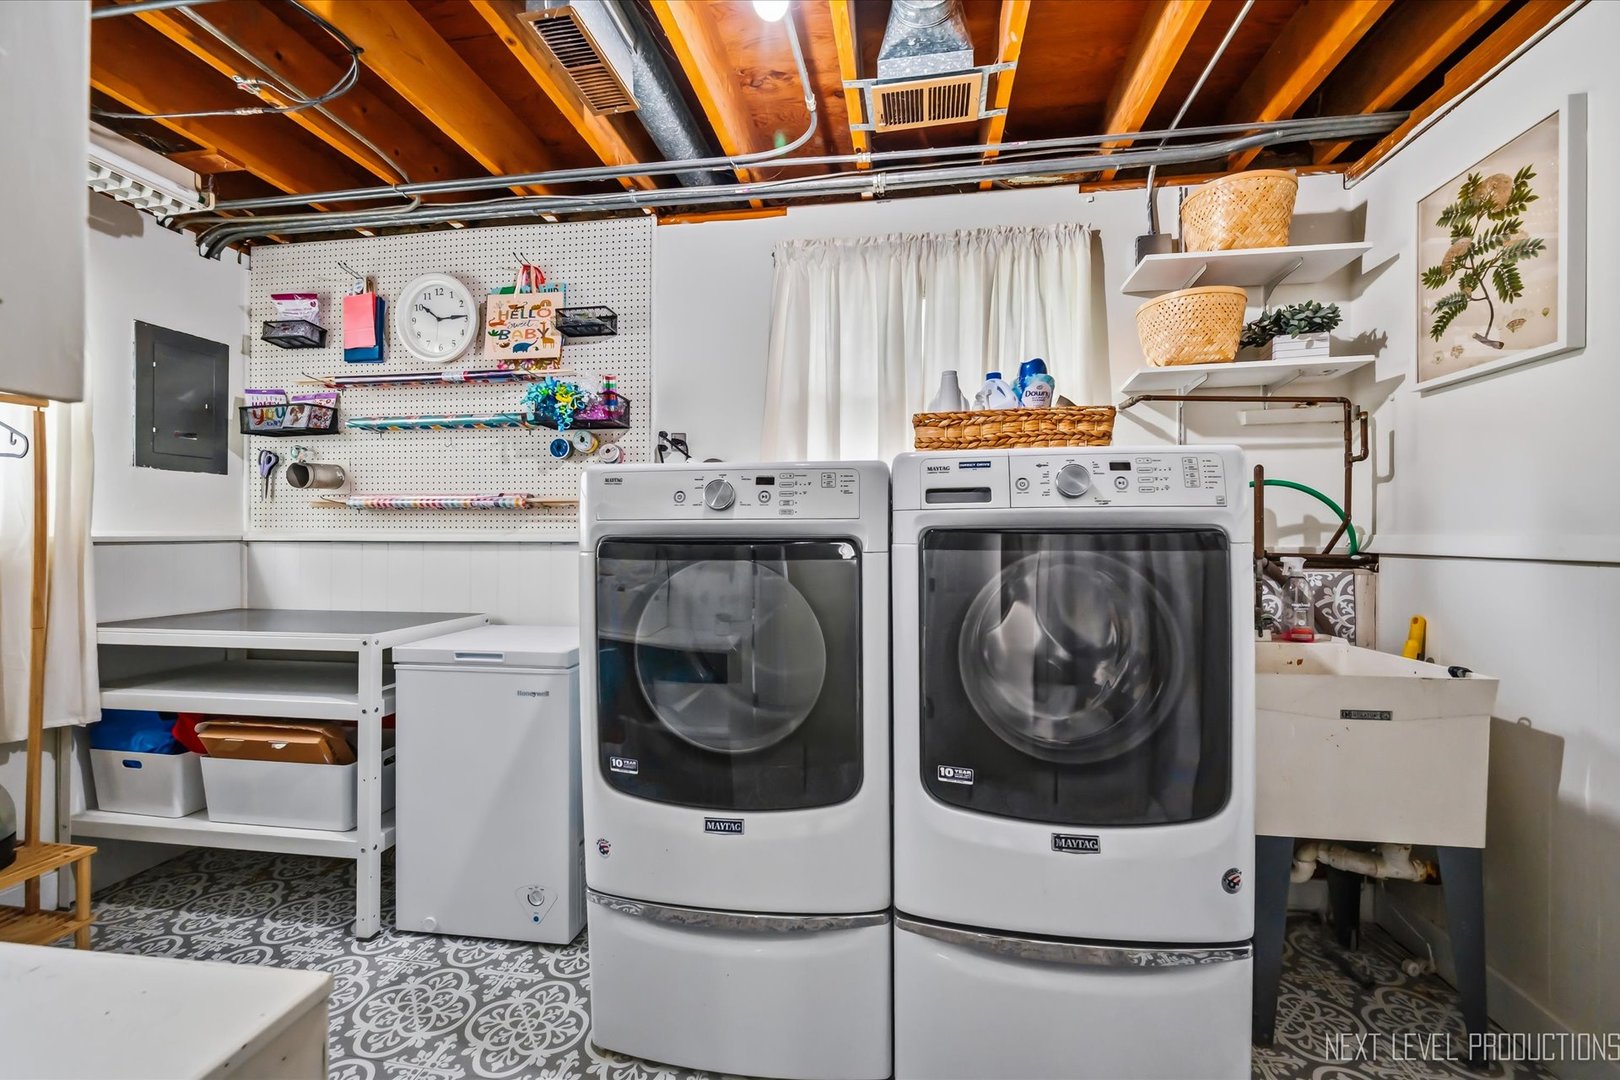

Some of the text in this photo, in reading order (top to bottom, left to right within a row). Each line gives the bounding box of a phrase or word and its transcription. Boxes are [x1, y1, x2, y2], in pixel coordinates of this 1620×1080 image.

[435, 288, 444, 296] 12
[450, 291, 454, 299] 1
[415, 304, 424, 312] 10
[459, 300, 464, 308] 2
[498, 308, 552, 320] HELLO
[411, 317, 417, 325] 9
[498, 328, 550, 340] BABY
[1025, 391, 1051, 399] Downy
[517, 690, 549, 698] Honeywell
[612, 758, 623, 768] 10
[940, 767, 954, 777] 10
[706, 821, 742, 832] MAYTAG
[1055, 837, 1099, 849] MAYTAG
